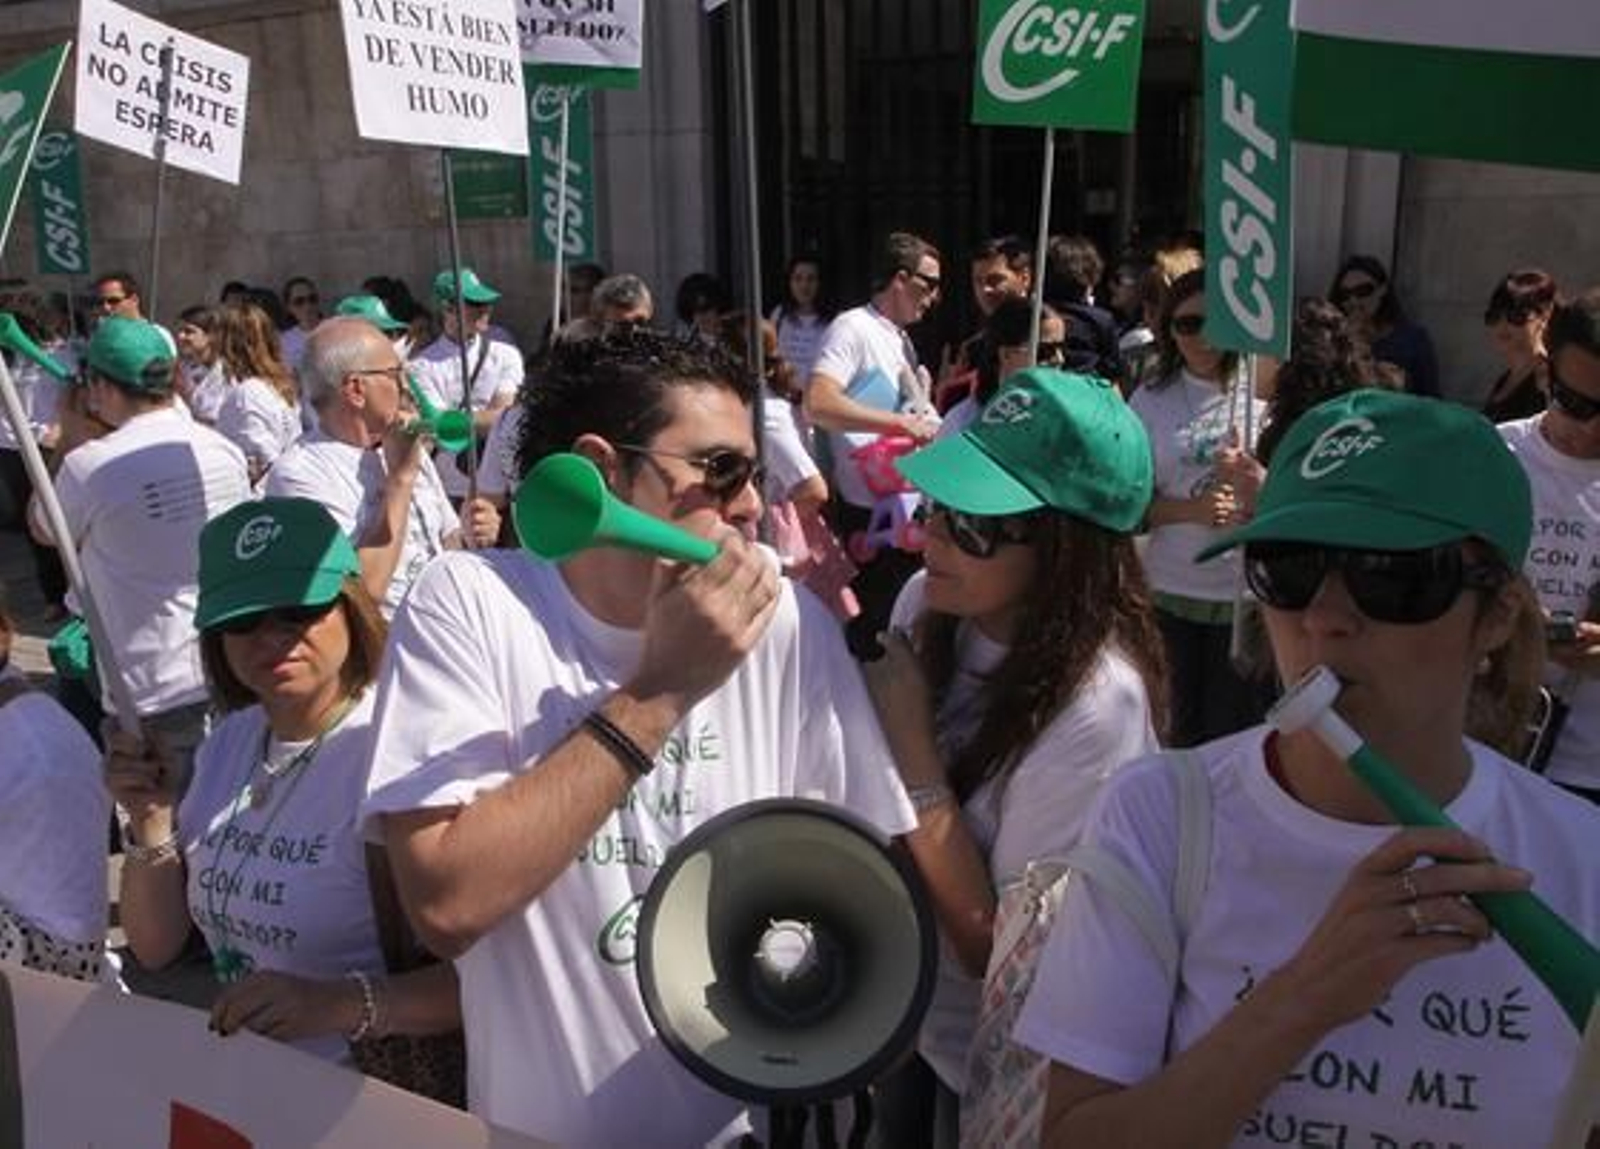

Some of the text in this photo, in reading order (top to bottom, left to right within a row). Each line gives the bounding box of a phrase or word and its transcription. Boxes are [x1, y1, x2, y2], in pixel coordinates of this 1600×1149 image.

[393, 0, 454, 36] ESTÁ
[461, 14, 512, 46] BIEN
[98, 22, 233, 94] LA CISIS
[364, 33, 518, 87] DE VENDER
[87, 53, 239, 129] NO AMITE
[406, 83, 490, 121] HUMO
[270, 833, 329, 864] QUÉ
[251, 880, 286, 906] MI
[1421, 987, 1531, 1042] QUÉ
[1283, 1051, 1479, 1112] ON MI
